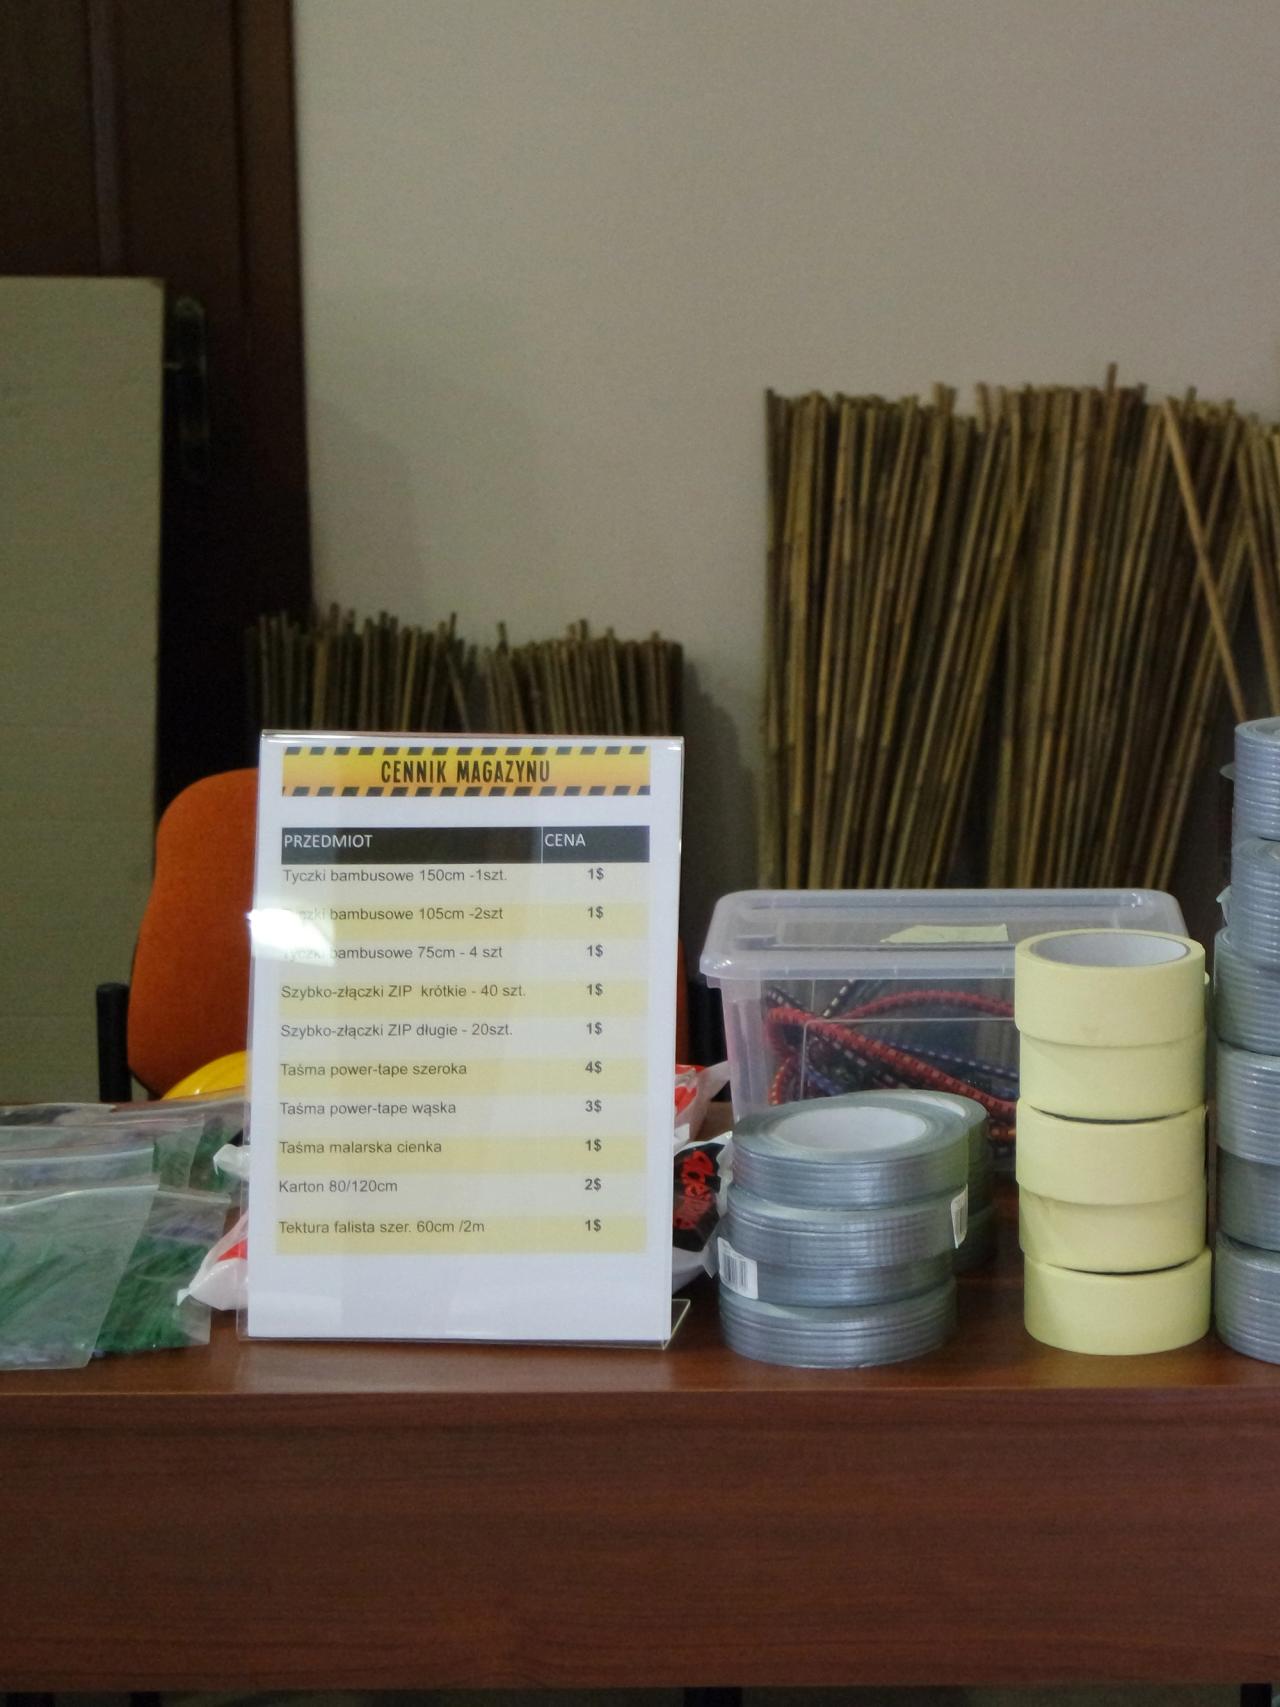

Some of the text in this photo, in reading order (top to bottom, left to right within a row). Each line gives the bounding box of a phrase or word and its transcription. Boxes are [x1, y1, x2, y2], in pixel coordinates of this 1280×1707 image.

[381, 760, 551, 784] CENNIK MAGAZYNU
[284, 834, 372, 849] PRZEDMIOT
[545, 833, 586, 847] CENA
[284, 868, 507, 884] Tyczki bambusowe 150cm -1szt.
[588, 868, 605, 881] 1$
[330, 907, 413, 920] bambusowe
[420, 907, 464, 920] 105cm
[469, 907, 503, 920] -2szt
[588, 907, 604, 920] 1$
[418, 946, 455, 959] 75cm
[469, 946, 478, 958] 4
[482, 946, 502, 958] szt
[587, 945, 604, 958] 1$
[281, 985, 384, 1002] Szybko-złączki
[389, 986, 412, 998] ZIP
[421, 985, 467, 998] krótkie
[481, 985, 498, 998] 40
[502, 985, 525, 998] szt.
[587, 984, 603, 997] 1$
[281, 1024, 384, 1041] Szybko-złączki
[388, 1024, 411, 1037] ZIP
[416, 1024, 457, 1041] długie
[472, 1024, 512, 1037] 20szt.
[587, 1023, 602, 1035] 1$
[281, 1063, 467, 1080] Taśma power-tape szeroka
[585, 1060, 602, 1075] 4$
[280, 1102, 456, 1119] Taśma power-tape wąska
[585, 1100, 602, 1114] 3$
[280, 1141, 442, 1154] Taśma malarska cienka
[585, 1139, 602, 1153] 1$
[279, 1180, 398, 1193] Karton 80/120cm
[585, 1178, 602, 1193] 2$
[279, 1221, 485, 1234] Tektura falista szer. 60cm /2m
[585, 1219, 601, 1233] 1$
